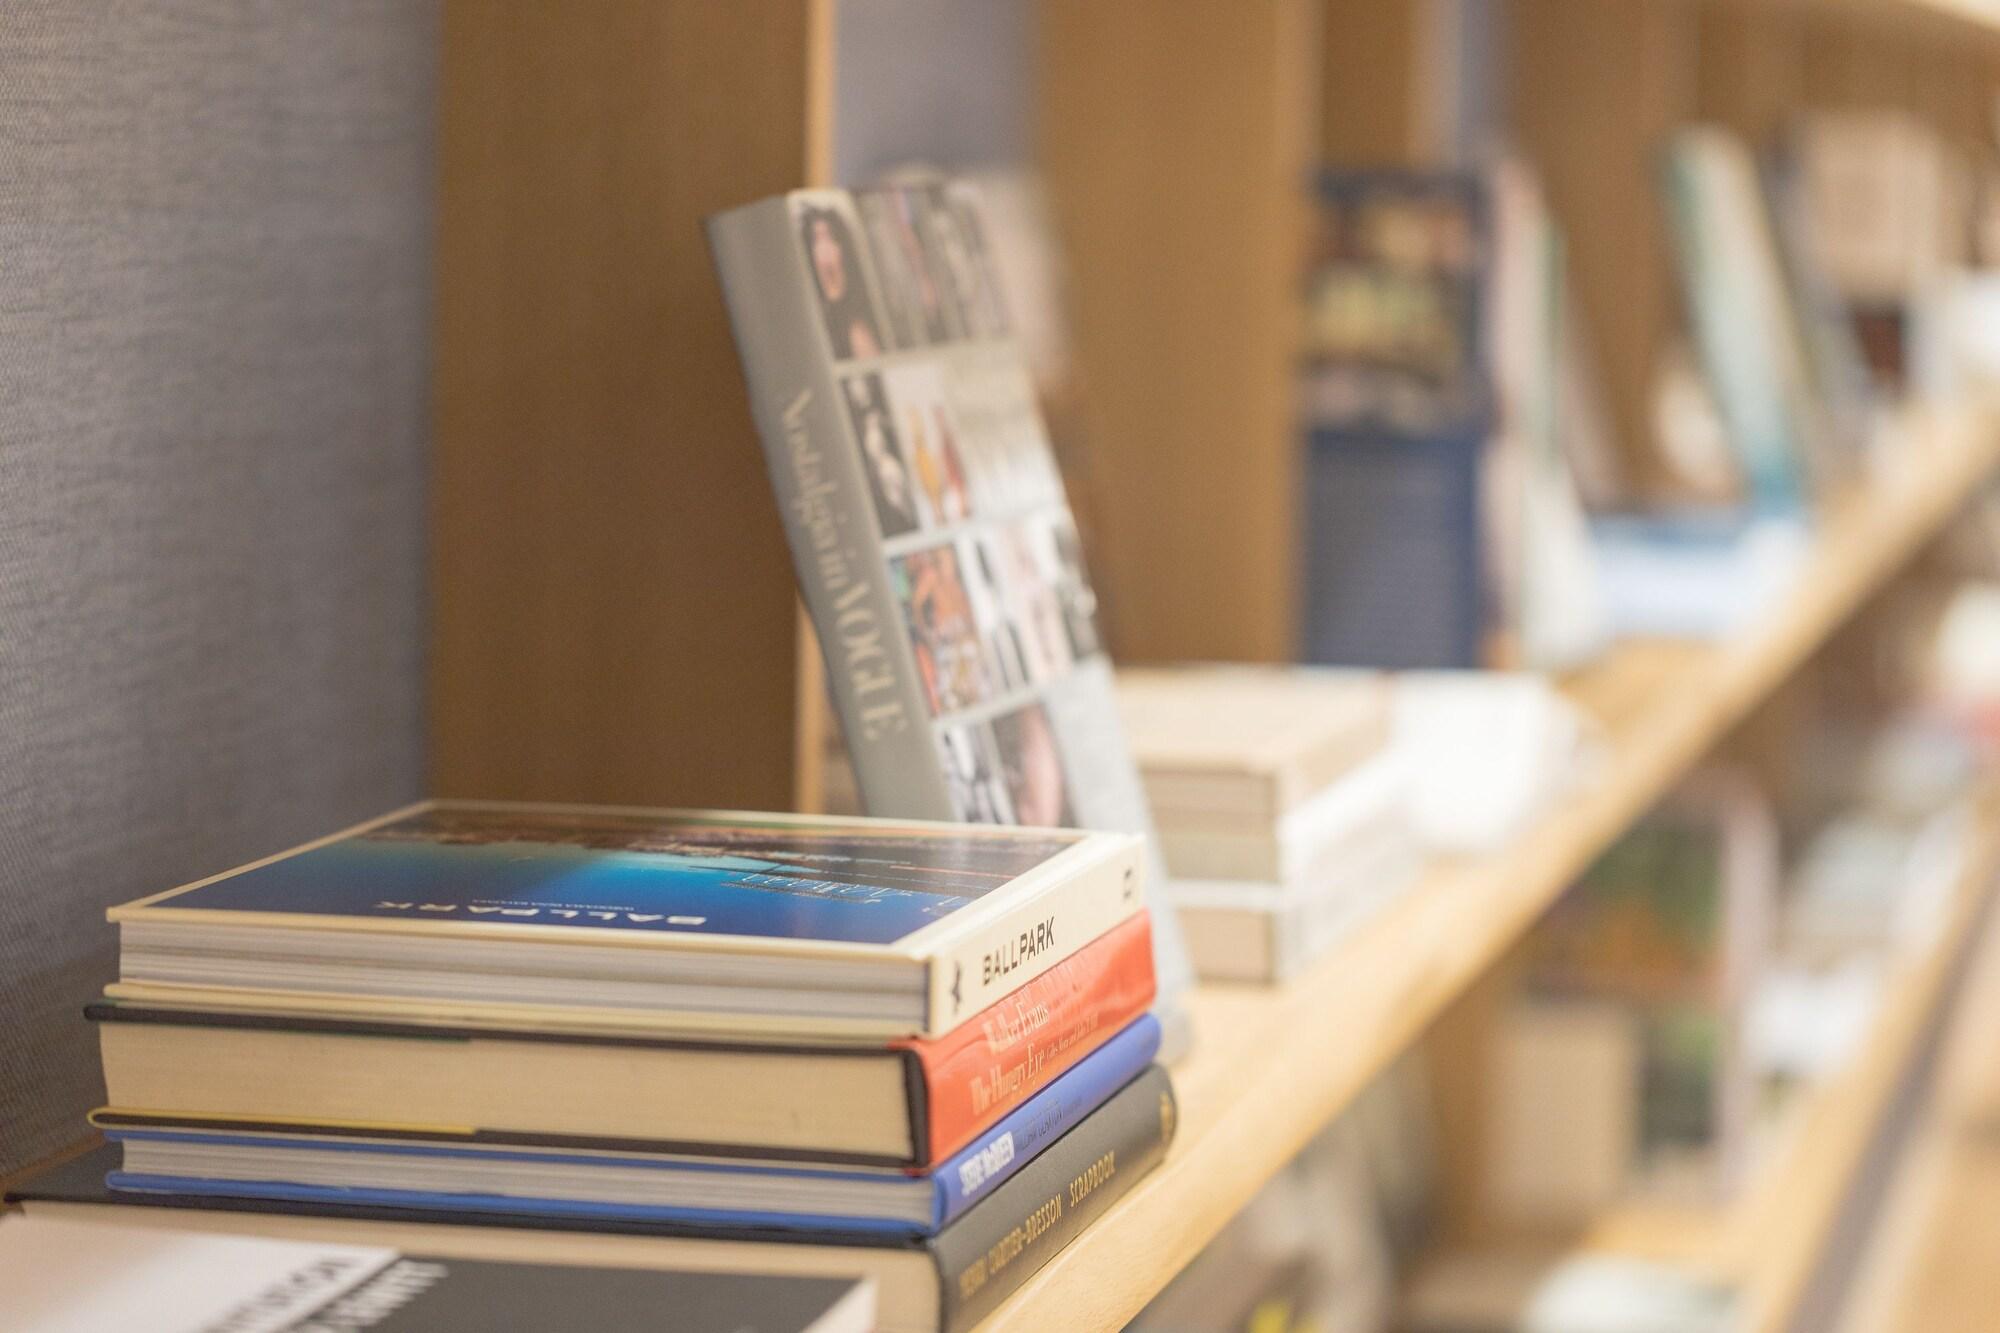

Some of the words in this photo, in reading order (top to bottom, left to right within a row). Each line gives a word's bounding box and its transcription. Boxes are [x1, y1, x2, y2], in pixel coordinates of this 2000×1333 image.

[833, 580, 908, 741] VOGUE
[373, 901, 706, 925] BALLPARK
[982, 916, 1056, 987] BALLPARK
[1069, 1150, 1117, 1208] SCRAPBOOK
